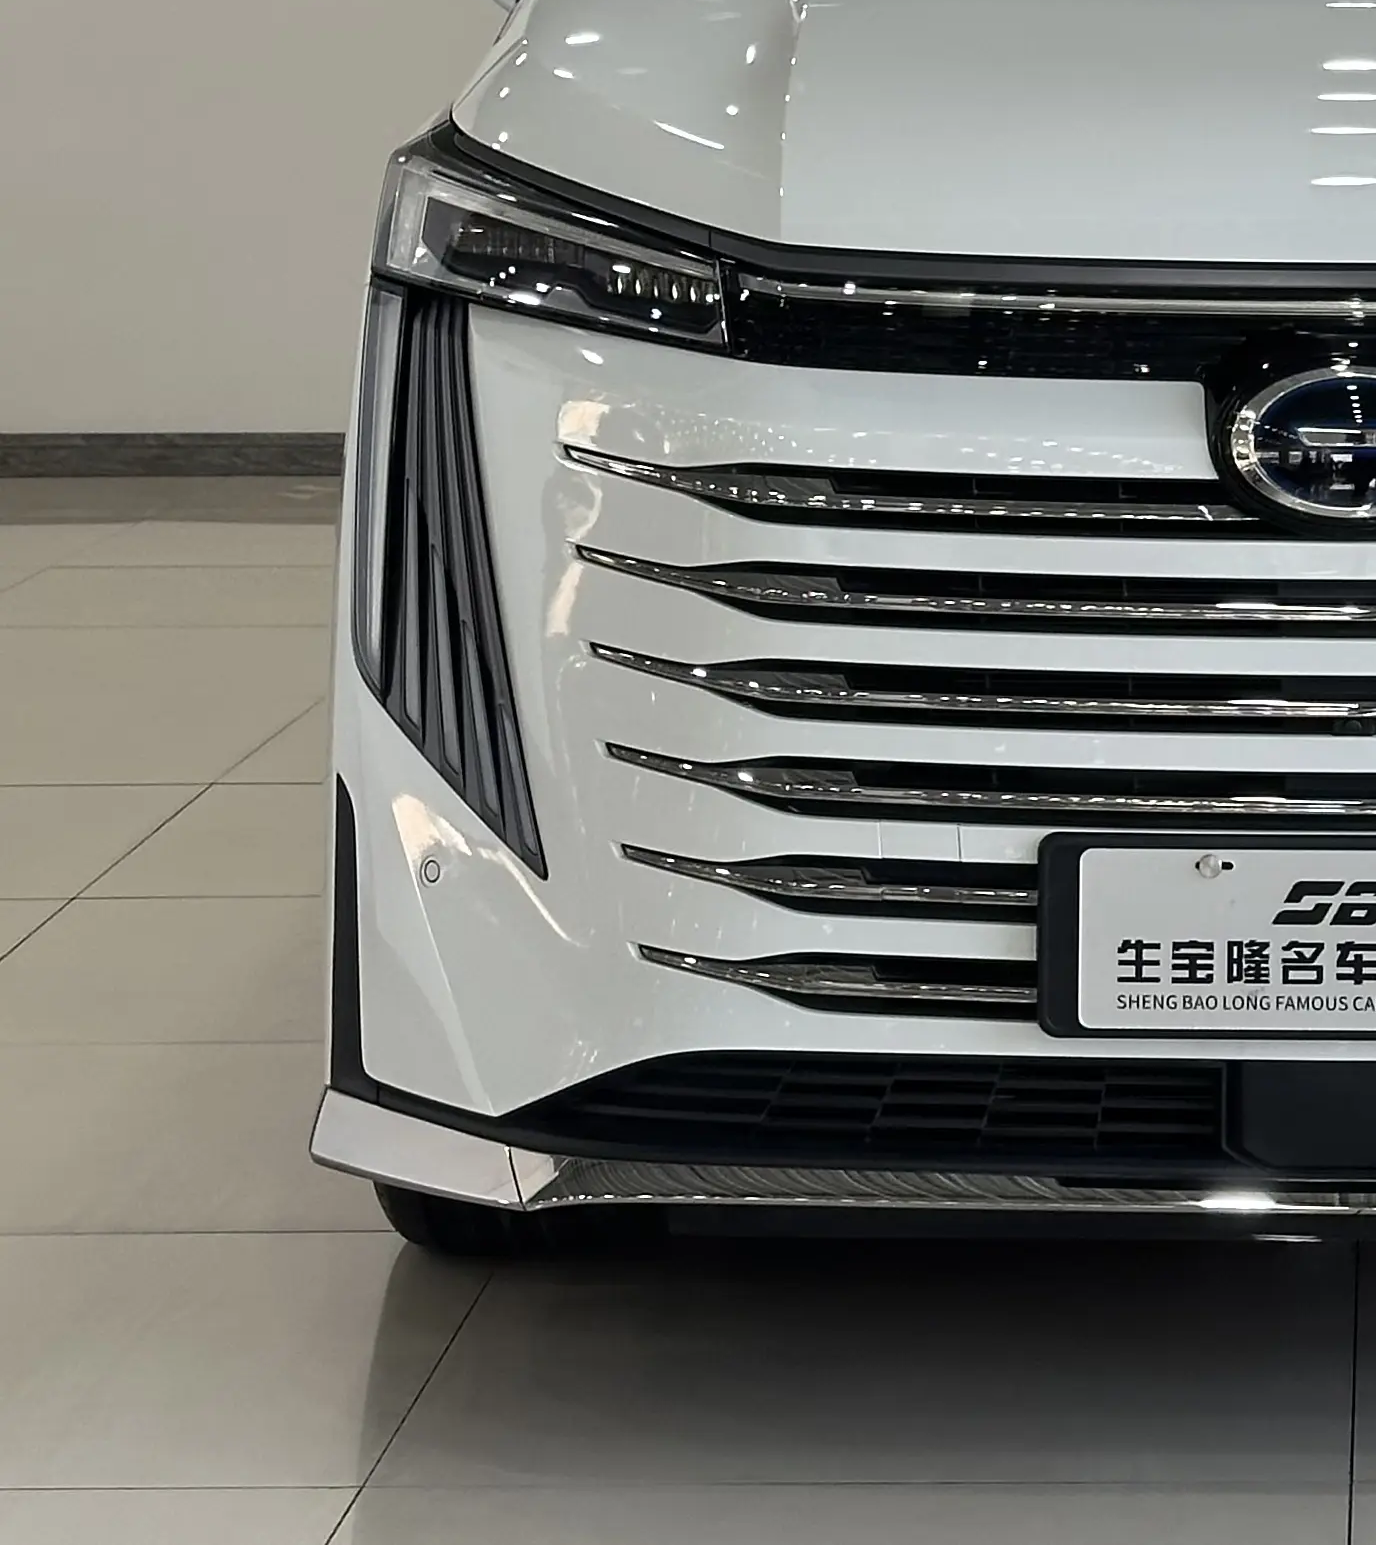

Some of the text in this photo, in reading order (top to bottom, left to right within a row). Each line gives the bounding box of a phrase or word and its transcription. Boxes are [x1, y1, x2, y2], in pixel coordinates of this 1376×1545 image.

[1116, 994, 1178, 1010] SHENG
[1182, 995, 1218, 1011] BAO
[1222, 995, 1271, 1011] LONG
[1275, 995, 1349, 1012] FAMOUS
